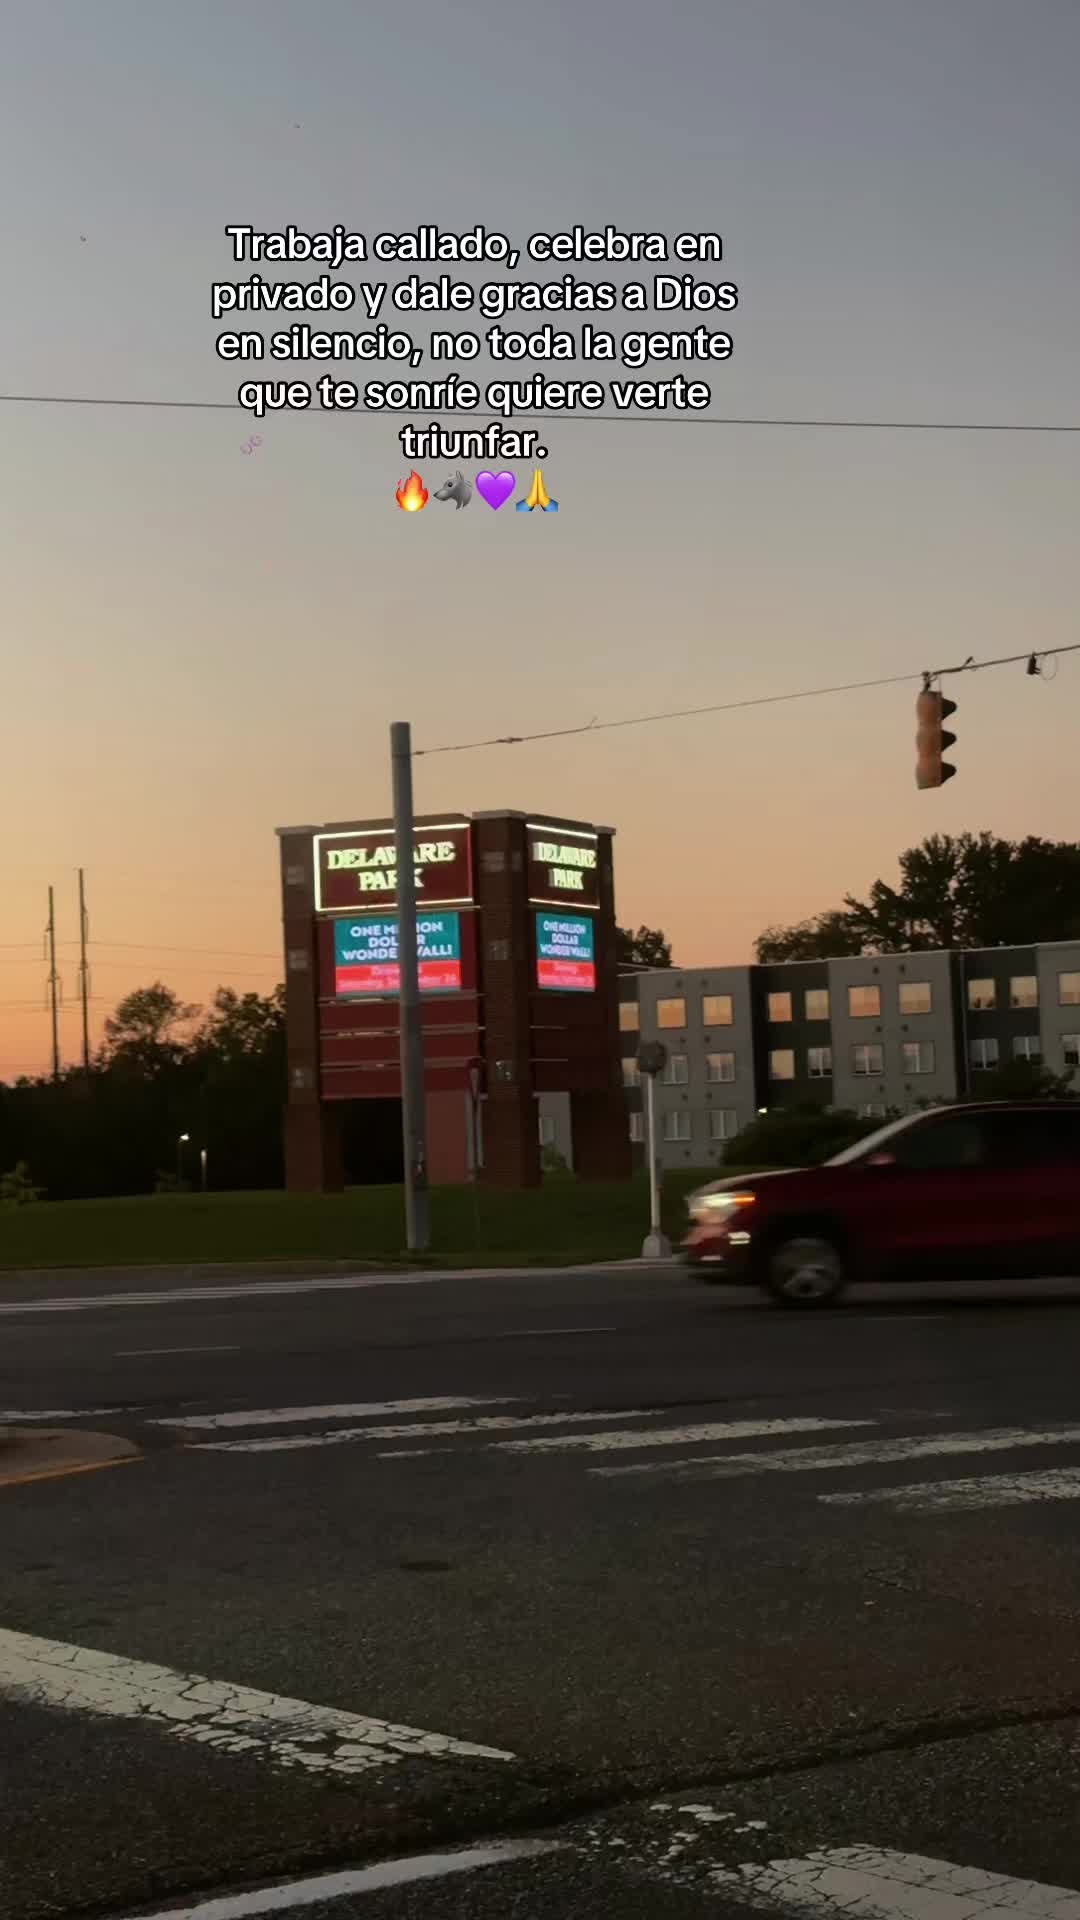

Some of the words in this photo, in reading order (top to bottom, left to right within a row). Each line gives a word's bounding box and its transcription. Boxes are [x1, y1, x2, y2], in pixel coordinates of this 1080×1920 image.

[549, 867, 585, 890] PARK
[350, 924, 381, 937] ONE
[368, 934, 426, 949] DOLR
